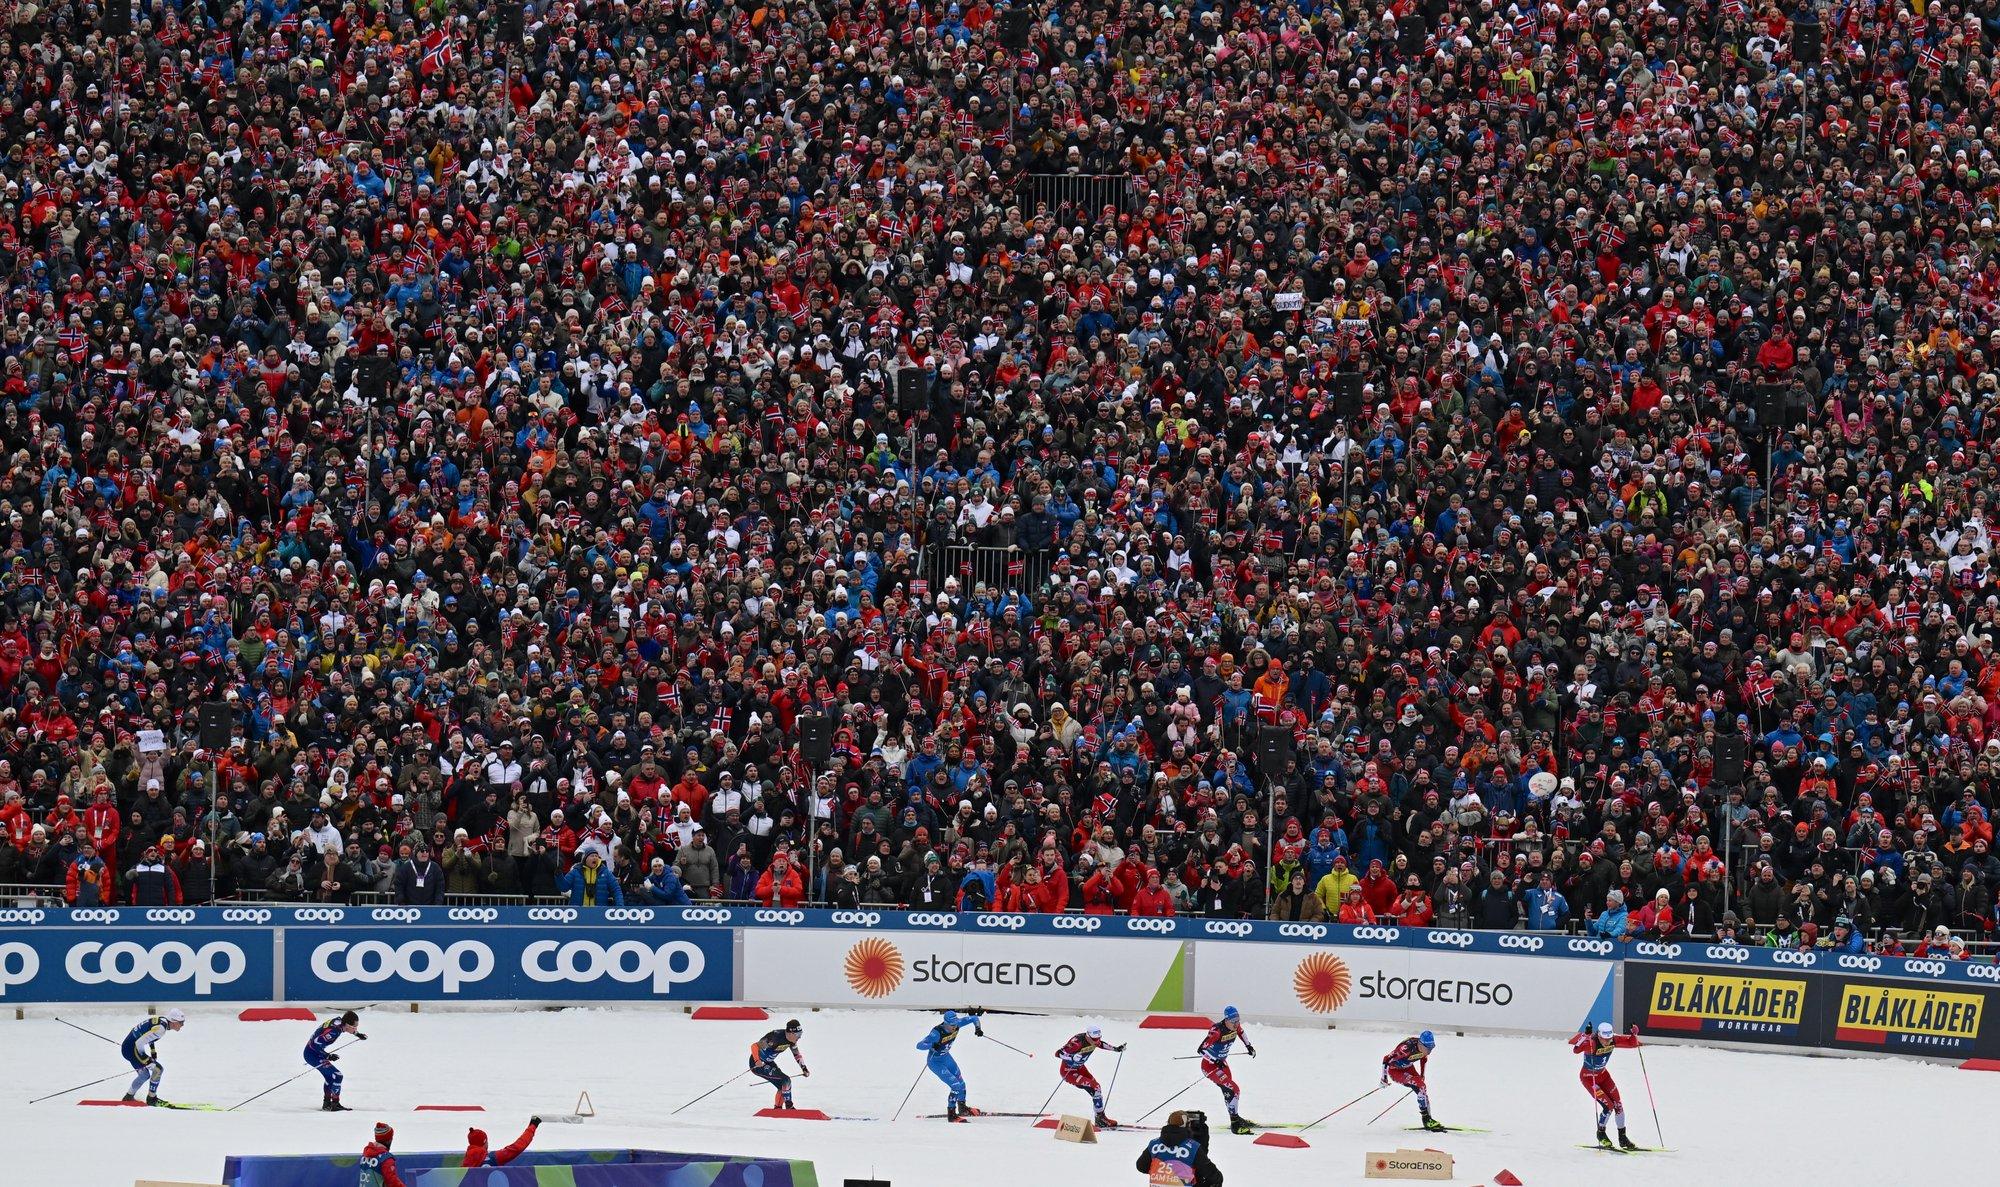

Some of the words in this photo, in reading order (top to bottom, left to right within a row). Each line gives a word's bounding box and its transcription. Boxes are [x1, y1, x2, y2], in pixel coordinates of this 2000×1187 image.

[71, 909, 120, 924] coop
[146, 909, 196, 924] coop
[222, 909, 272, 924] coop
[294, 908, 345, 924] coop
[371, 908, 421, 923] coop
[448, 908, 499, 923] coop
[527, 908, 578, 923] coop
[604, 908, 655, 924] coop
[682, 909, 732, 924] coop
[754, 910, 805, 925] coop
[831, 911, 881, 926] coop
[907, 912, 958, 928] coop
[976, 914, 1026, 930] coop
[1052, 916, 1102, 932] coop
[1127, 917, 1176, 934] coop
[1204, 920, 1253, 938] coop
[1279, 923, 1327, 940] coop
[1352, 926, 1400, 943] coop
[1428, 930, 1474, 948] coop
[1498, 934, 1544, 952] coop
[1568, 938, 1614, 956] coop
[1636, 940, 1682, 959] coop
[1706, 945, 1750, 963] coop
[1772, 949, 1816, 968] coop
[65, 942, 246, 995] coop
[311, 940, 495, 993] coop
[522, 940, 706, 994] coop
[1838, 954, 1882, 972] coop
[1904, 958, 1946, 978] coop
[1657, 977, 1798, 1019] BLÅKLÄDER
[1845, 990, 1977, 1033] BLÅKLÄDER
[1718, 1021, 1782, 1033] WORKWEAR
[1901, 1034, 1960, 1047] WORKWEAR
[1157, 1161, 1173, 1175] 25
[1388, 1160, 1443, 1171] StoraEnso
